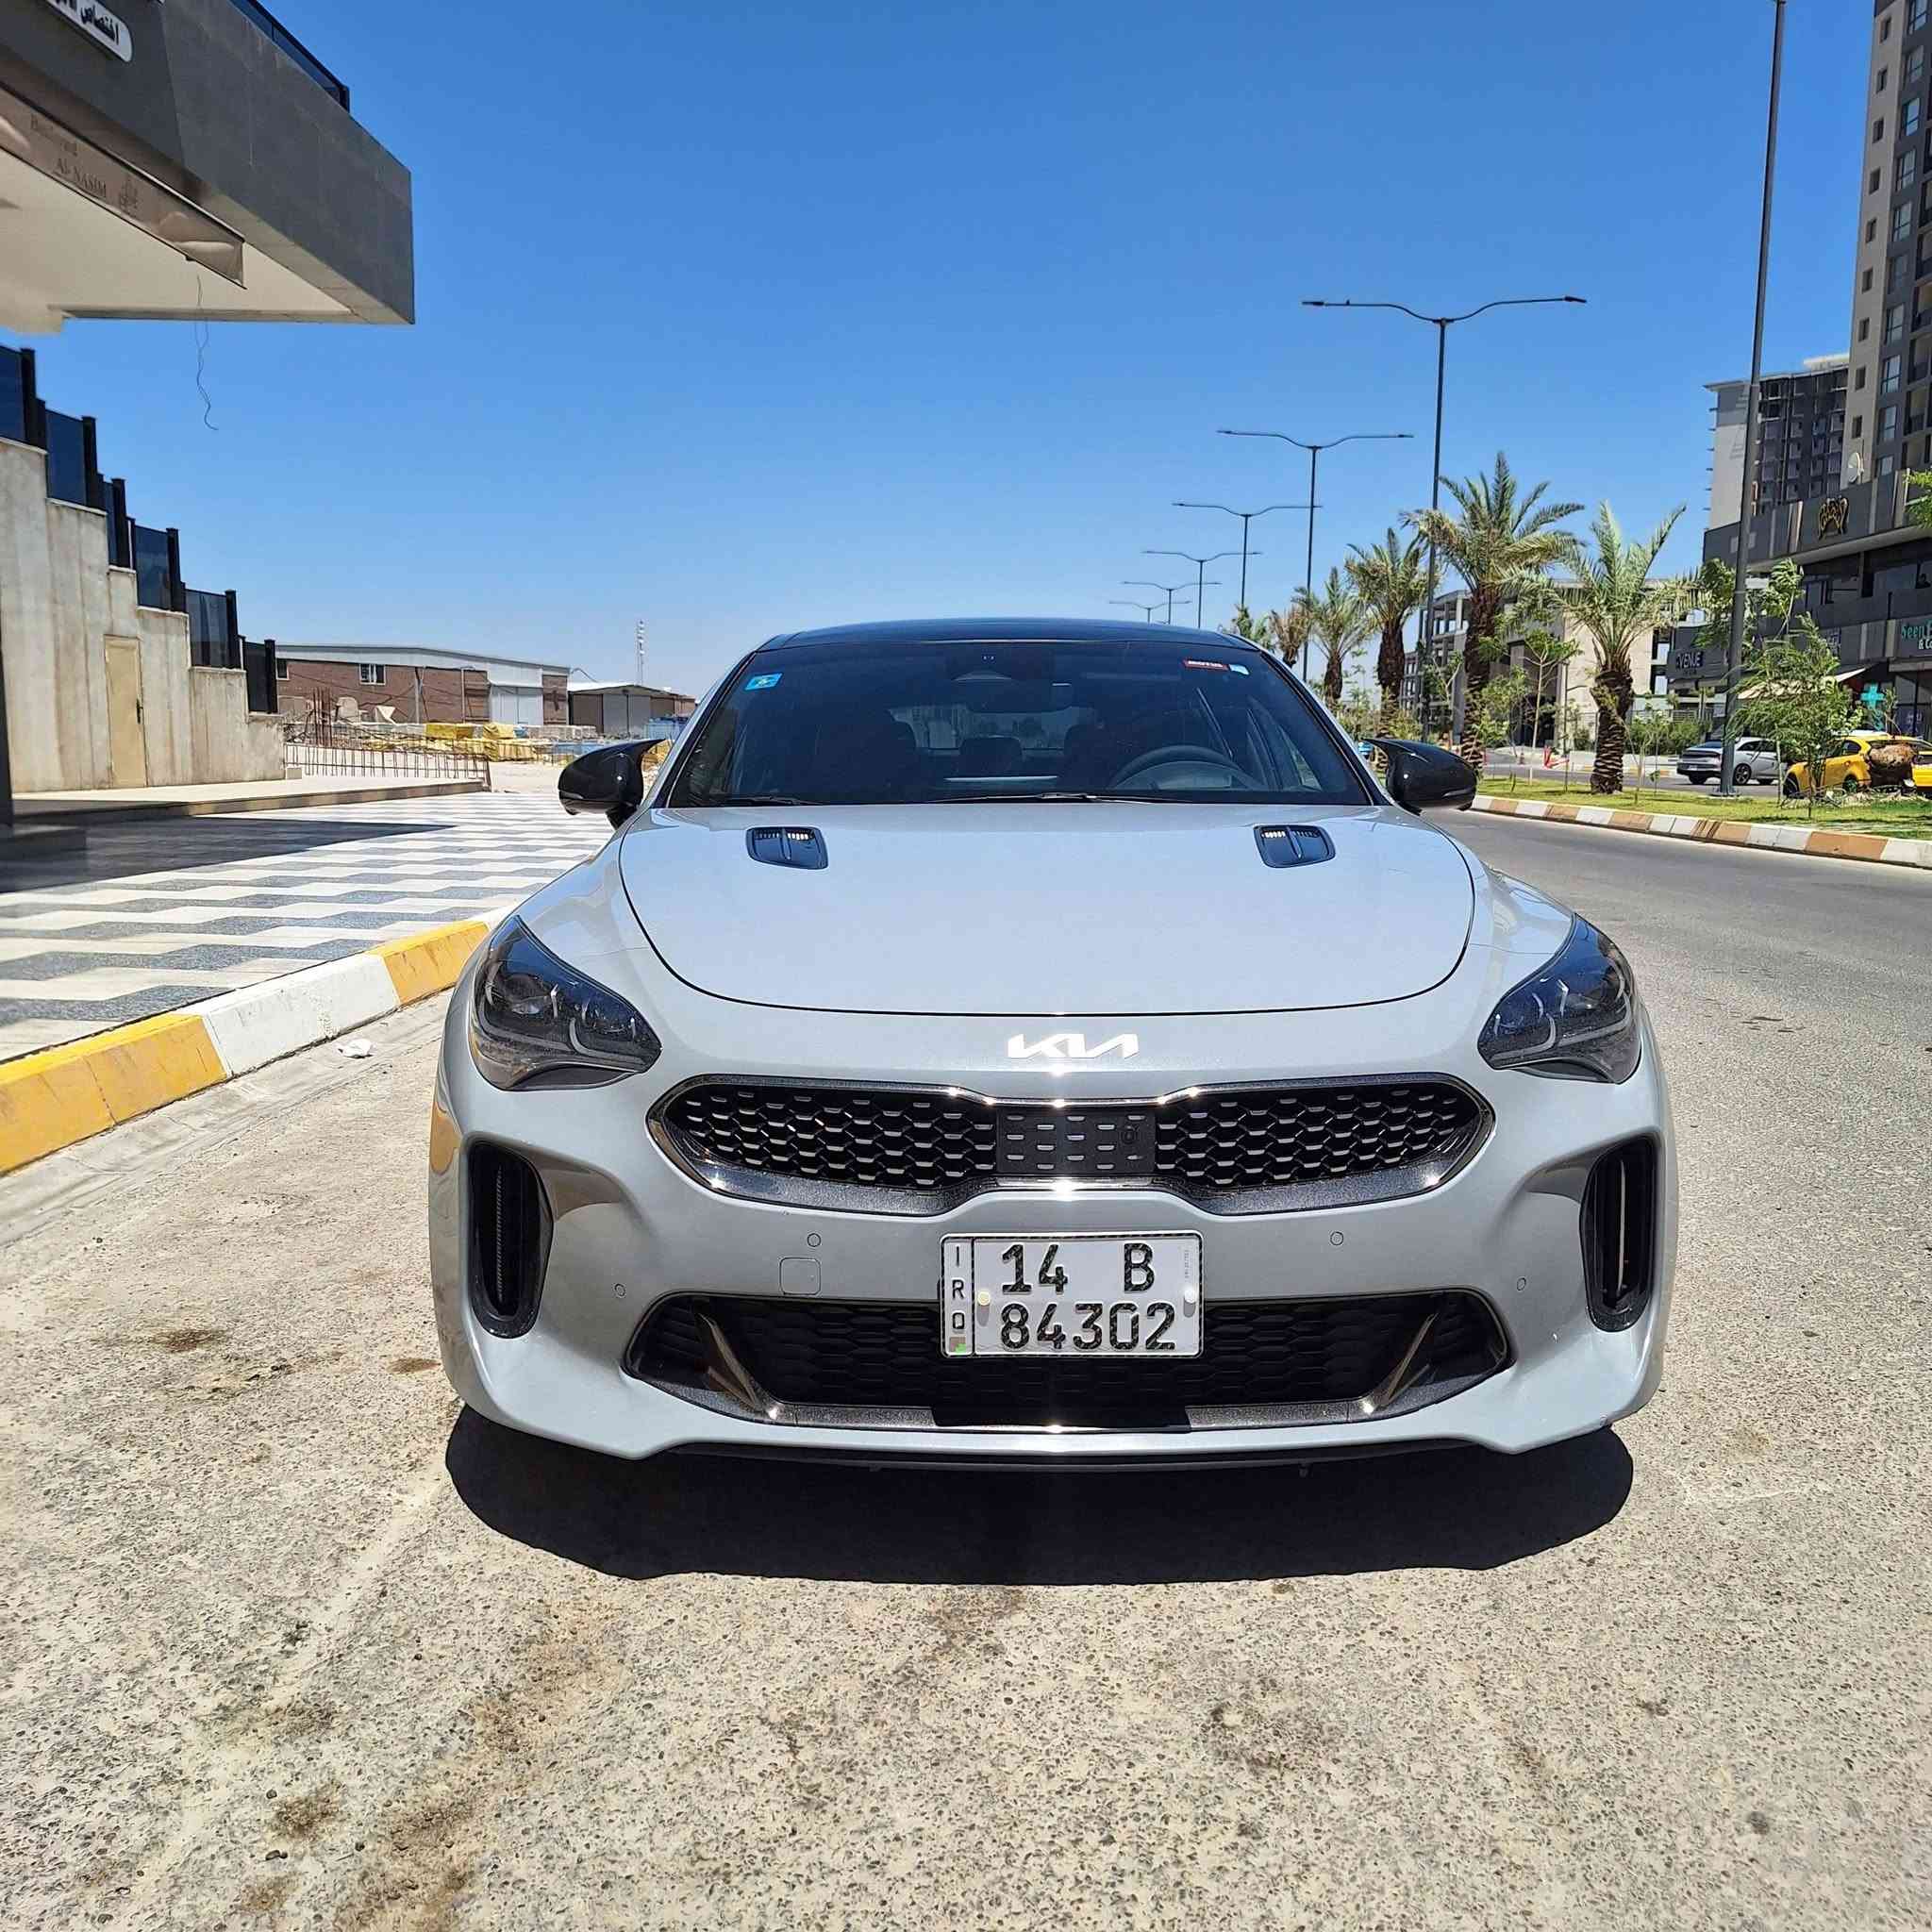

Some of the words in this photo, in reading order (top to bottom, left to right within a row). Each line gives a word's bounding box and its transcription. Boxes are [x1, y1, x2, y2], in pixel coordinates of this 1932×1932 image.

[1007, 1033, 1140, 1059] KIA
[1002, 1242, 1069, 1295] 14
[1124, 1242, 1156, 1293] B
[1000, 1302, 1176, 1350] 84302
